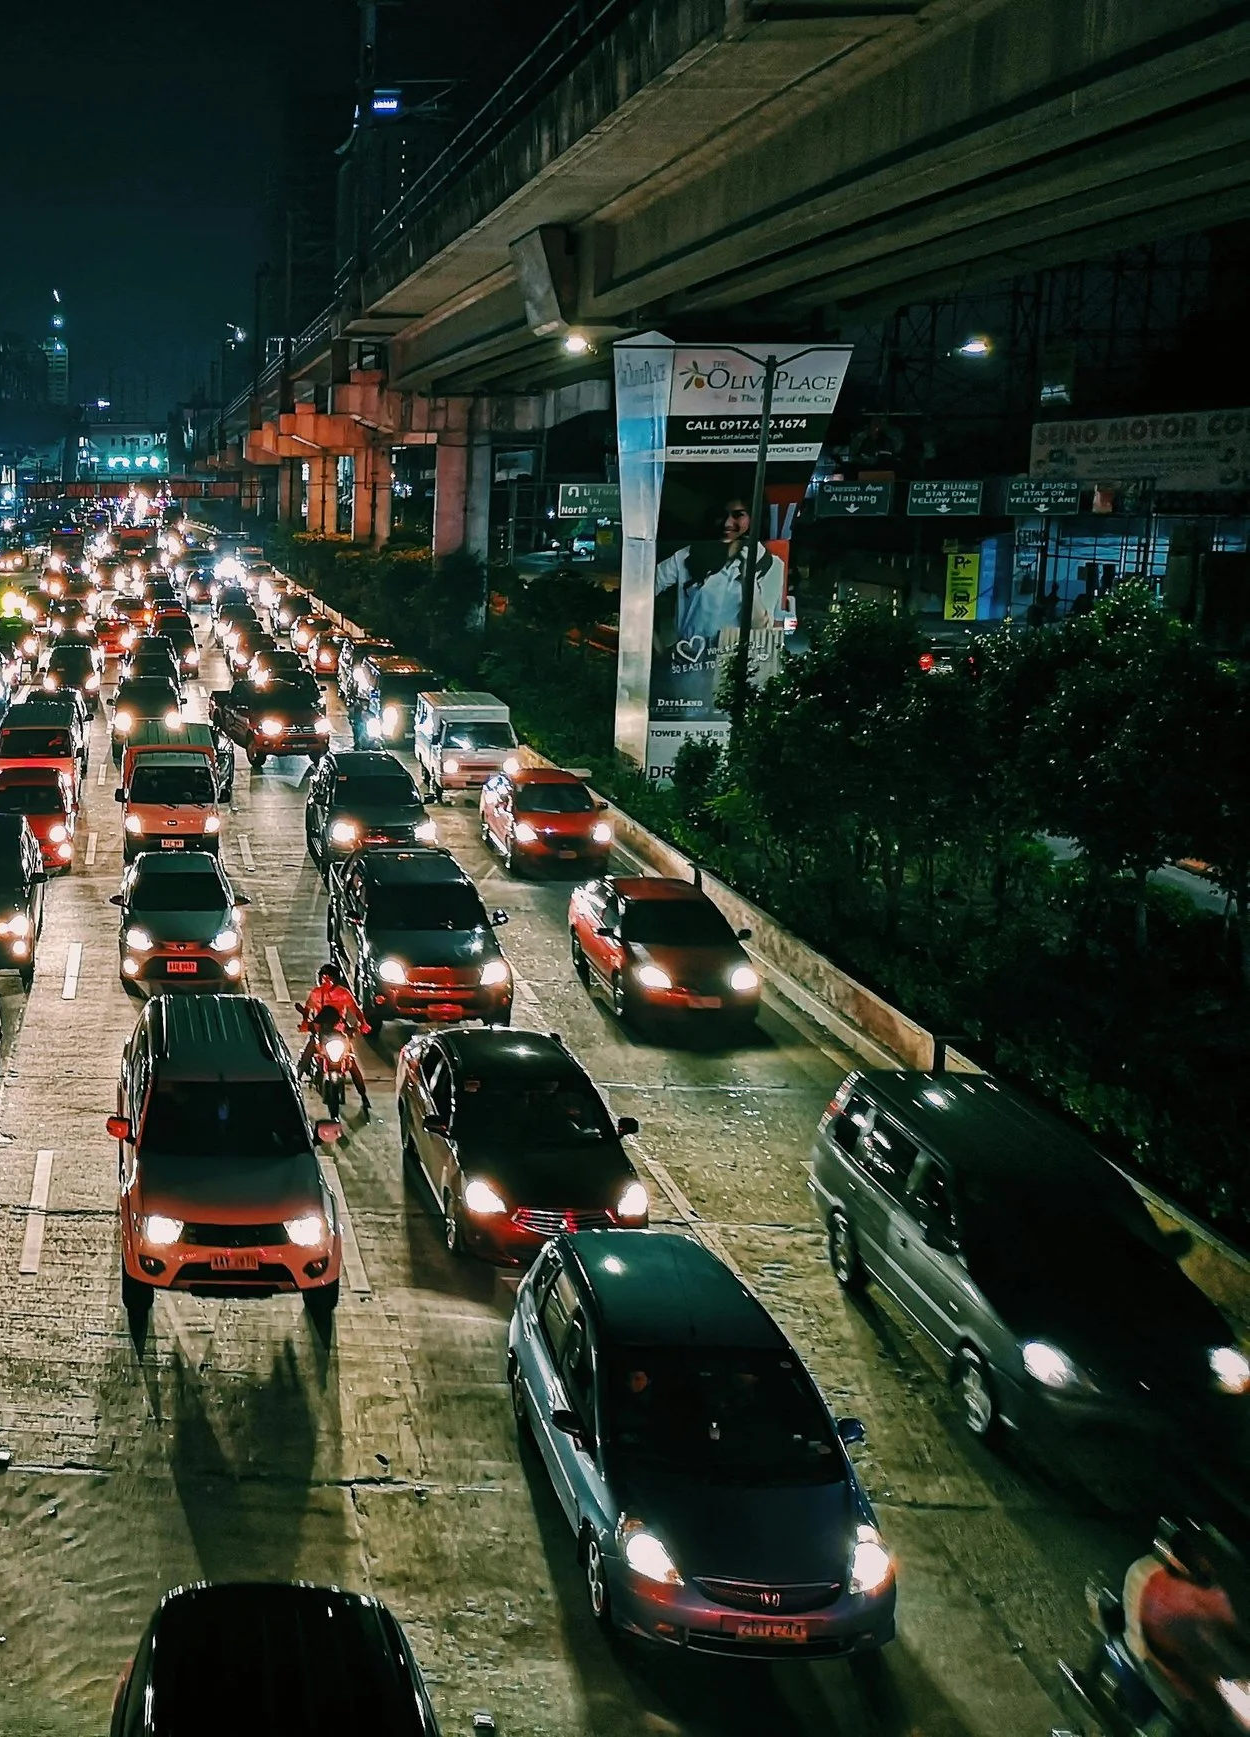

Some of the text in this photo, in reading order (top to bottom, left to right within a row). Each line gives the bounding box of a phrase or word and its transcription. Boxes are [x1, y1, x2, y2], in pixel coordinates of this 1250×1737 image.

[707, 368, 838, 389] OLIV PLACE
[685, 419, 807, 431] CALL 0917.69.1674
[1107, 416, 1198, 441] MOTOR
[701, 432, 784, 441] www.dataland.c.ph
[913, 483, 979, 491] CITY BUSES
[1011, 482, 1078, 490] CITY BUSES
[830, 493, 877, 504] Alabang
[561, 506, 588, 514] North
[682, 661, 703, 673] EASY
[705, 661, 715, 670] TO
